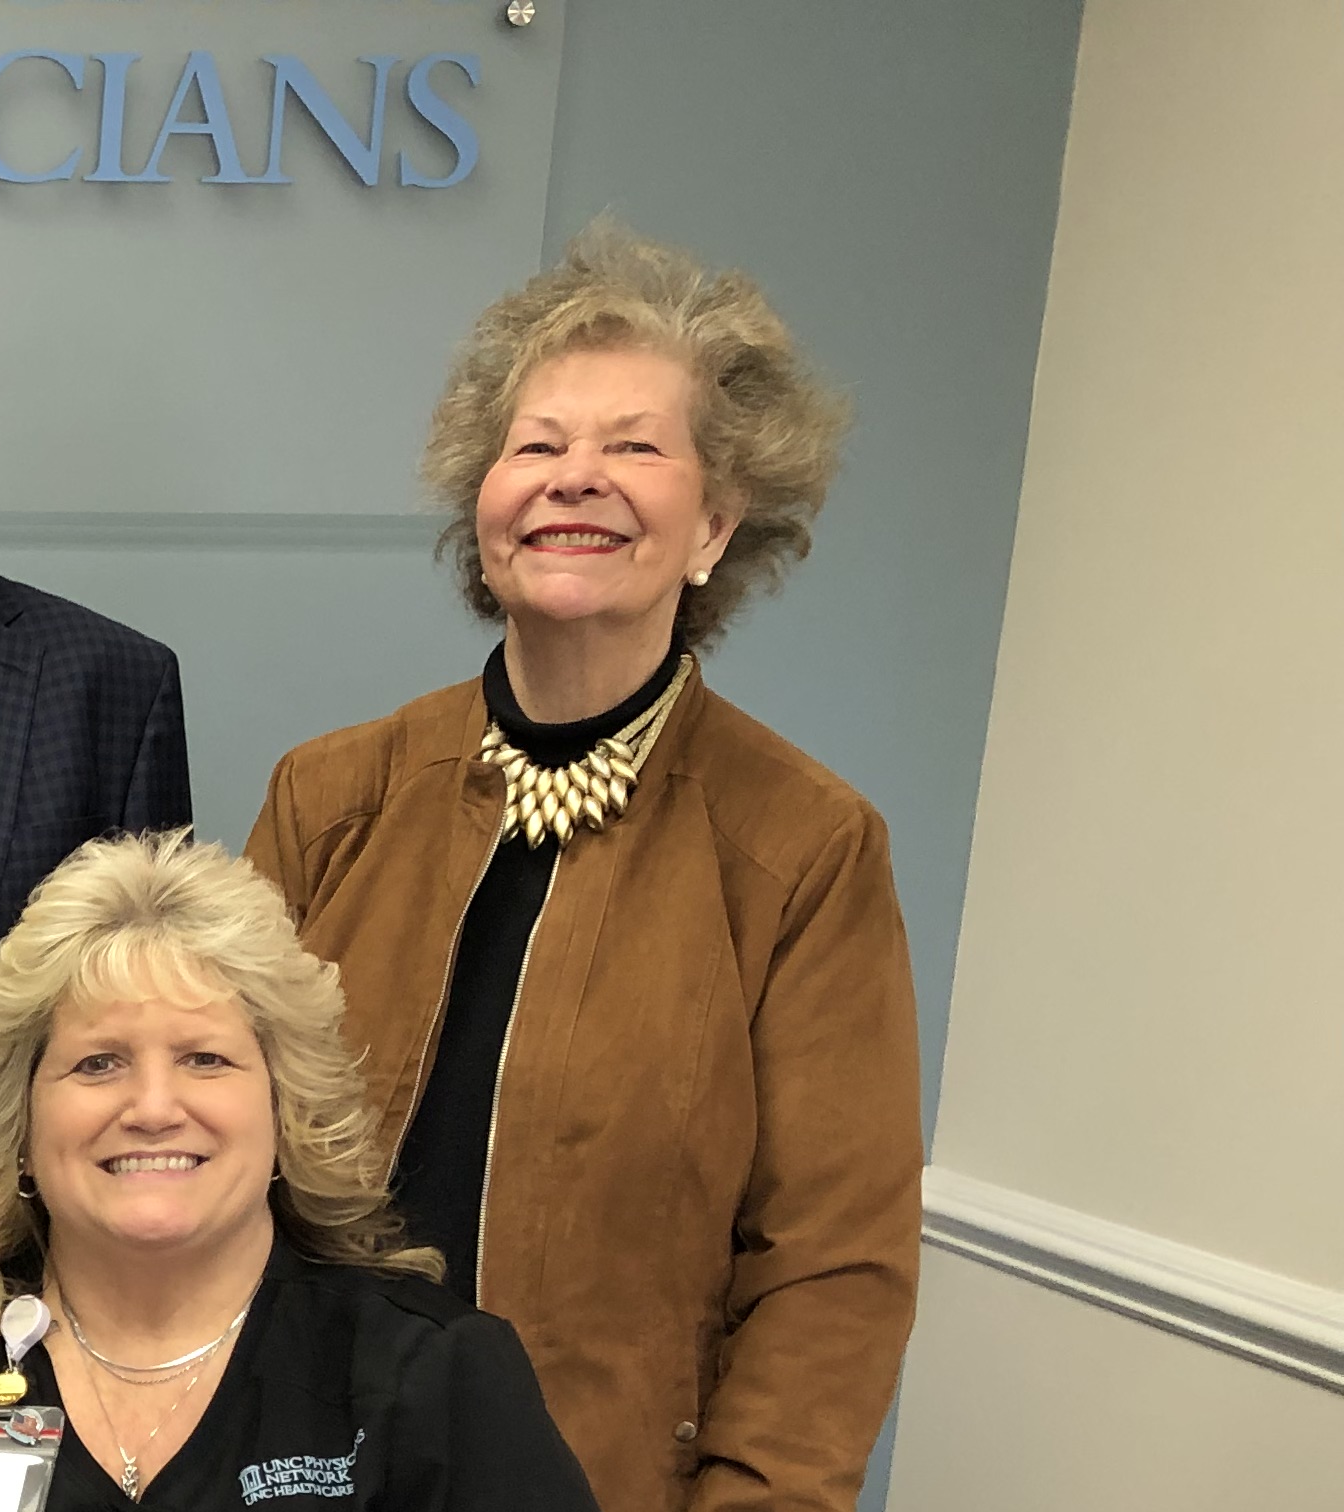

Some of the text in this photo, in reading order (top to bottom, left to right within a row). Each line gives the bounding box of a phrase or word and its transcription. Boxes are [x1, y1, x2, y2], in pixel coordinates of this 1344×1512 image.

[262, 1456, 304, 1473] UNC
[265, 1469, 352, 1486] NETWORK
[244, 1488, 274, 1506] UNC
